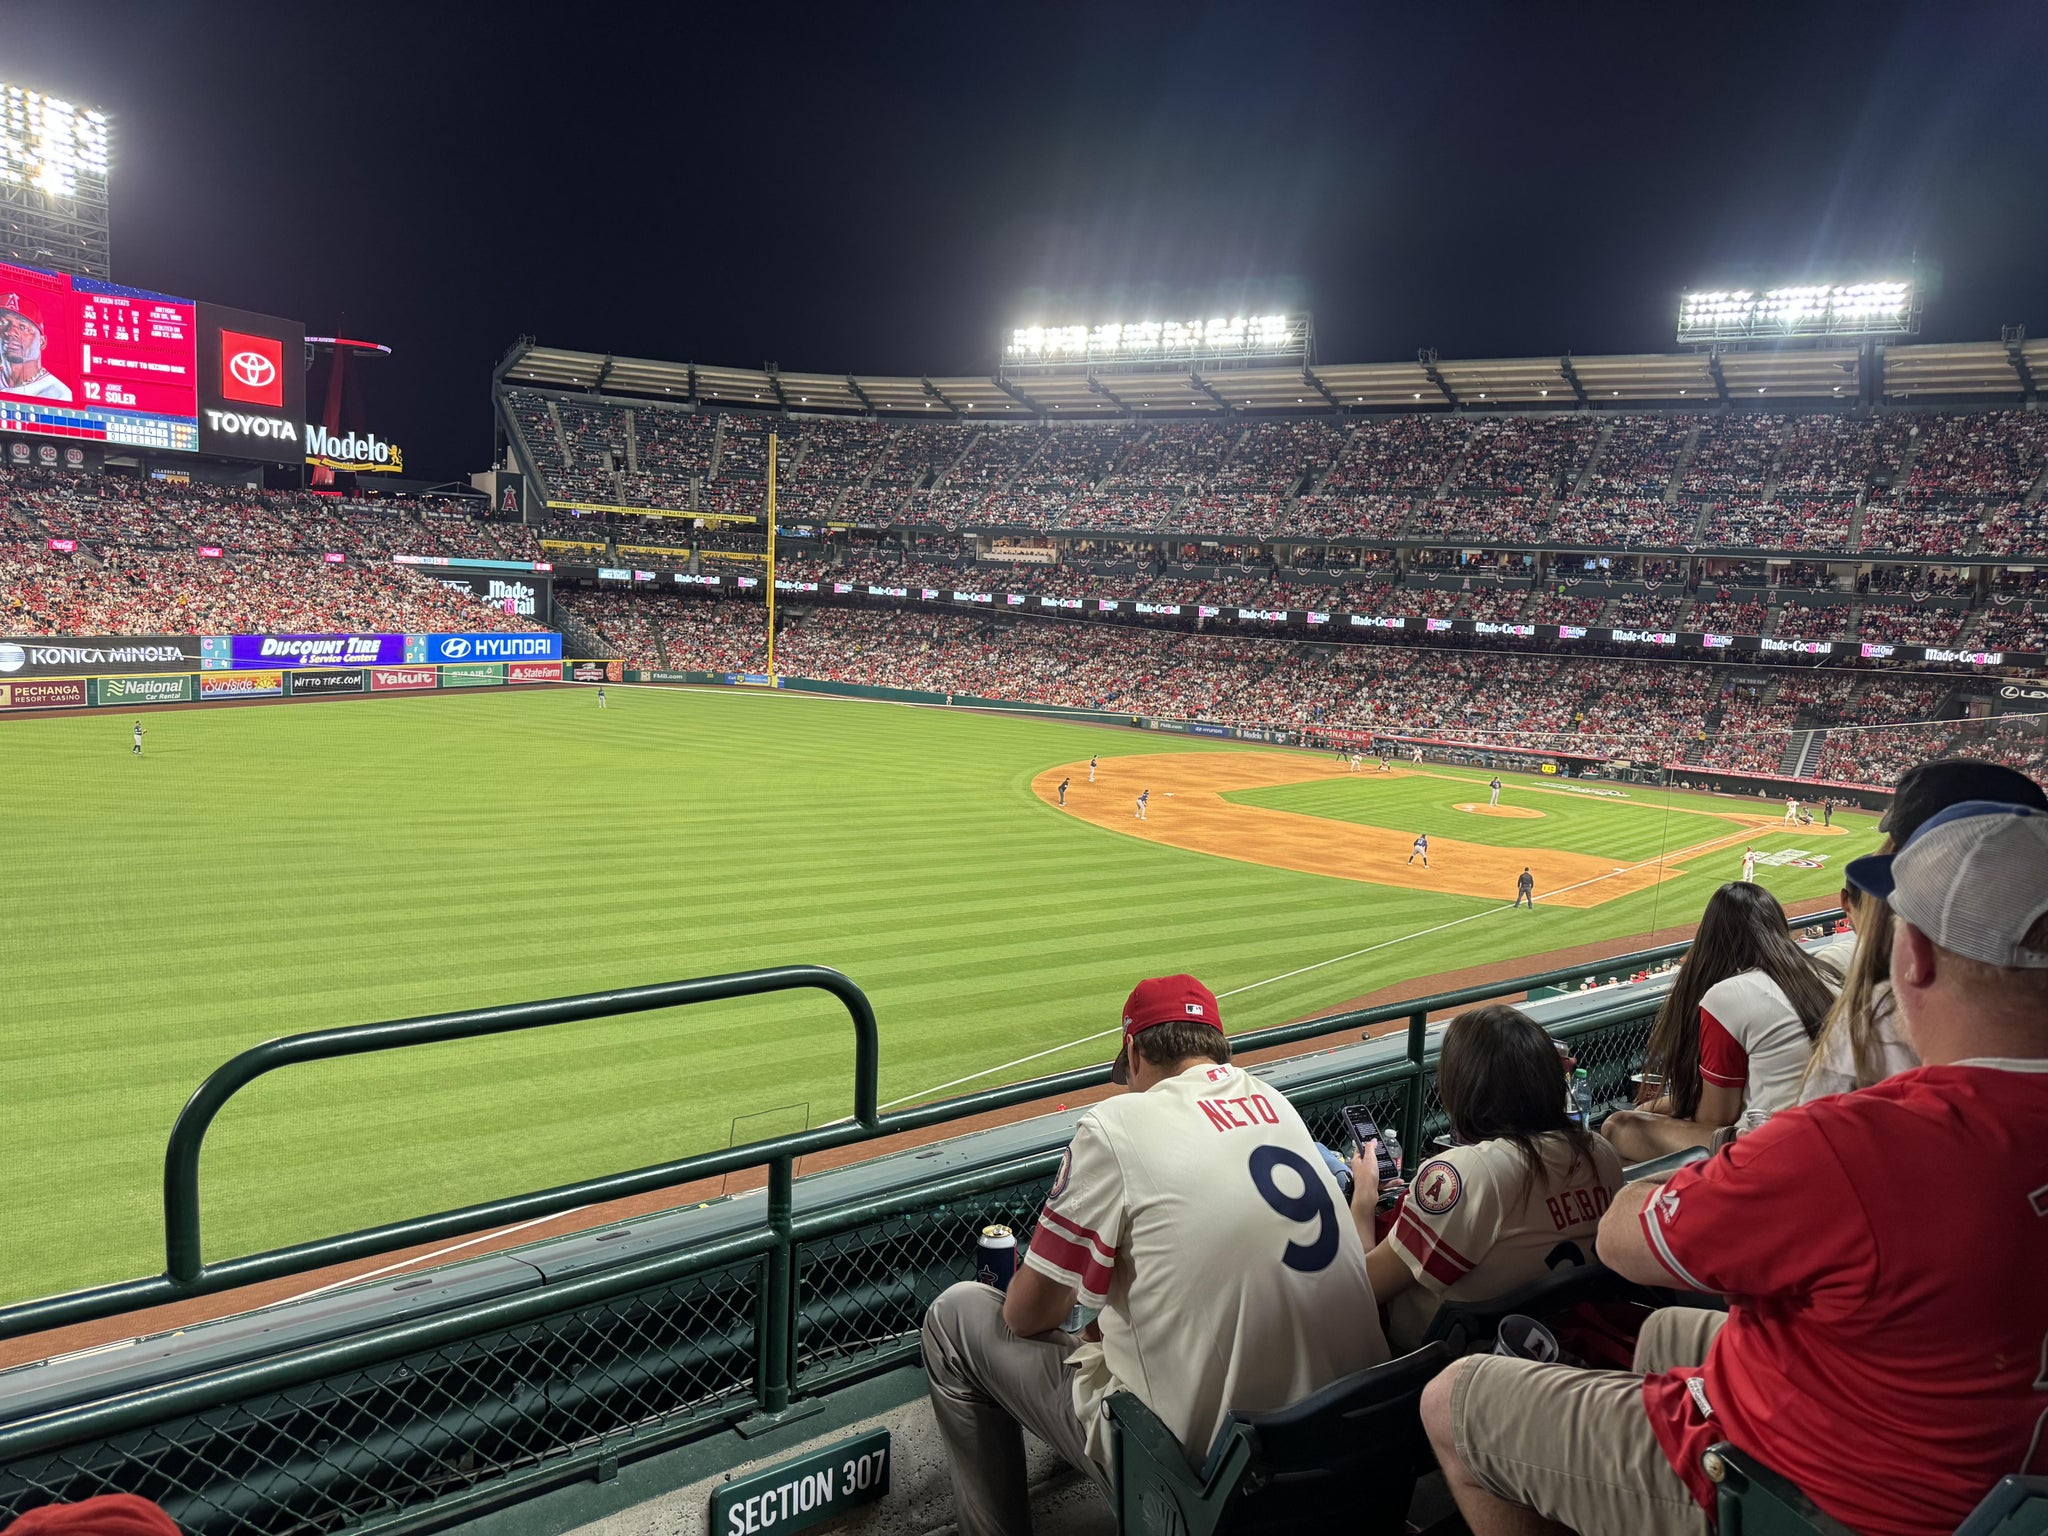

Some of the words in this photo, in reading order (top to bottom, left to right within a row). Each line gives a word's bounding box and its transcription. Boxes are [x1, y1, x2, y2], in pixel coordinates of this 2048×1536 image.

[83, 381, 101, 400] 12
[105, 391, 137, 406] SOLER
[206, 410, 298, 441] TOYOTA
[305, 424, 388, 462] Modelo
[15, 445, 28, 456] 30
[42, 447, 56, 458] 42
[68, 450, 82, 460] 50
[501, 485, 518, 512] A
[489, 580, 528, 599] Made
[1136, 603, 1153, 612] Made
[1239, 609, 1257, 618] Made
[1351, 615, 1372, 626] Made
[1476, 622, 1499, 632] Made
[1612, 630, 1637, 641] Made
[260, 639, 340, 656] DISCOUNT
[348, 638, 381, 654] TIRE
[475, 639, 550, 655] HYUNDAI
[1762, 638, 1788, 650] Made
[32, 648, 106, 665] KONICA
[109, 646, 185, 663] MINOLTA
[300, 656, 307, 664] &
[309, 655, 342, 663] Service
[343, 654, 378, 662] Centers
[1925, 648, 1954, 661] Made
[294, 678, 320, 687] NITTO
[321, 676, 361, 686] TIRE.COM
[377, 671, 432, 684] Yakult
[14, 686, 80, 696] PECHANGA
[125, 680, 183, 694] National
[205, 678, 253, 694] Surfside
[1244, 730, 1262, 740] Modelo
[1197, 1094, 1280, 1132] NETO
[1248, 1144, 1340, 1273] 9
[728, 1468, 833, 1536] SECTION
[842, 1449, 886, 1496] 307
